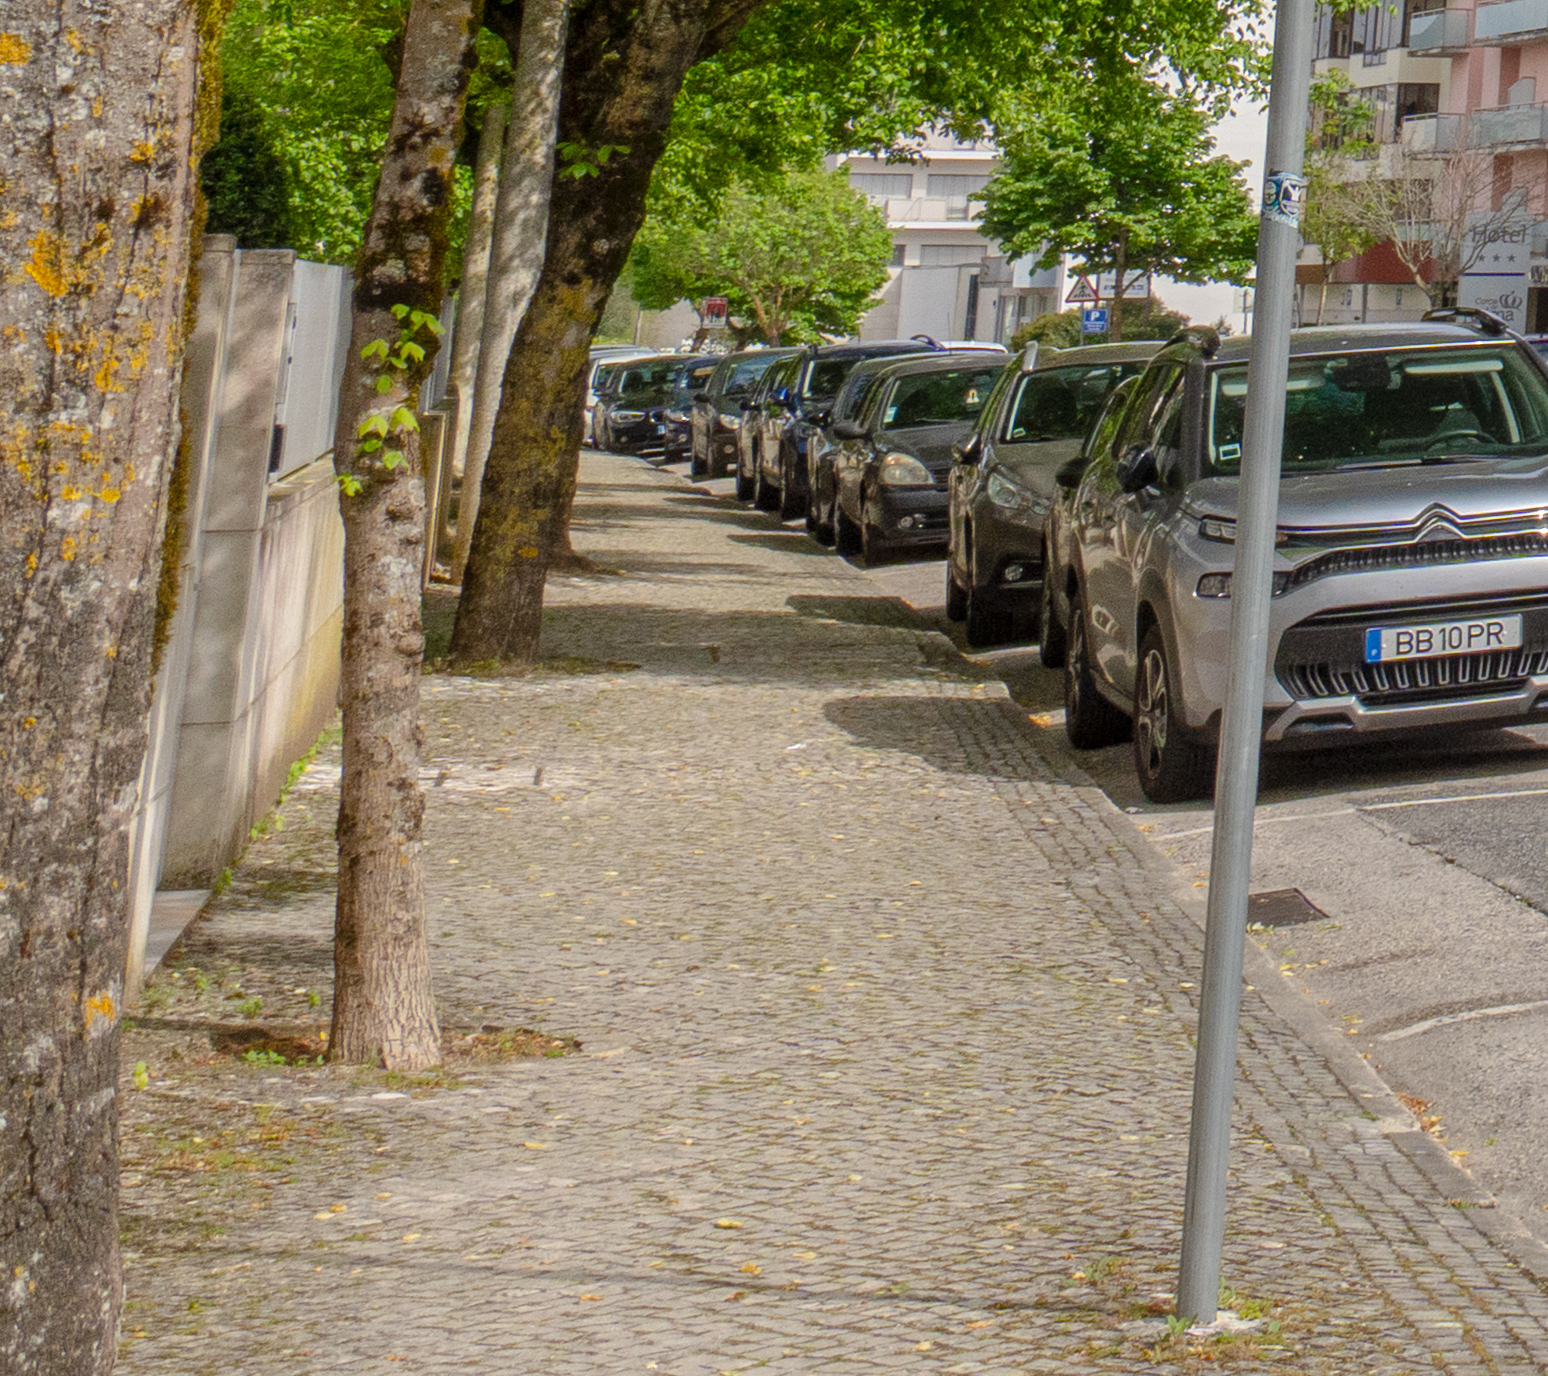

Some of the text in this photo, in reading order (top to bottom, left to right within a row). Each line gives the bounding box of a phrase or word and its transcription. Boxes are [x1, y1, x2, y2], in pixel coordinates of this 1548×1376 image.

[1471, 224, 1526, 244] Hotel
[1091, 311, 1101, 321] P
[1396, 622, 1505, 656] BB 10 PR
